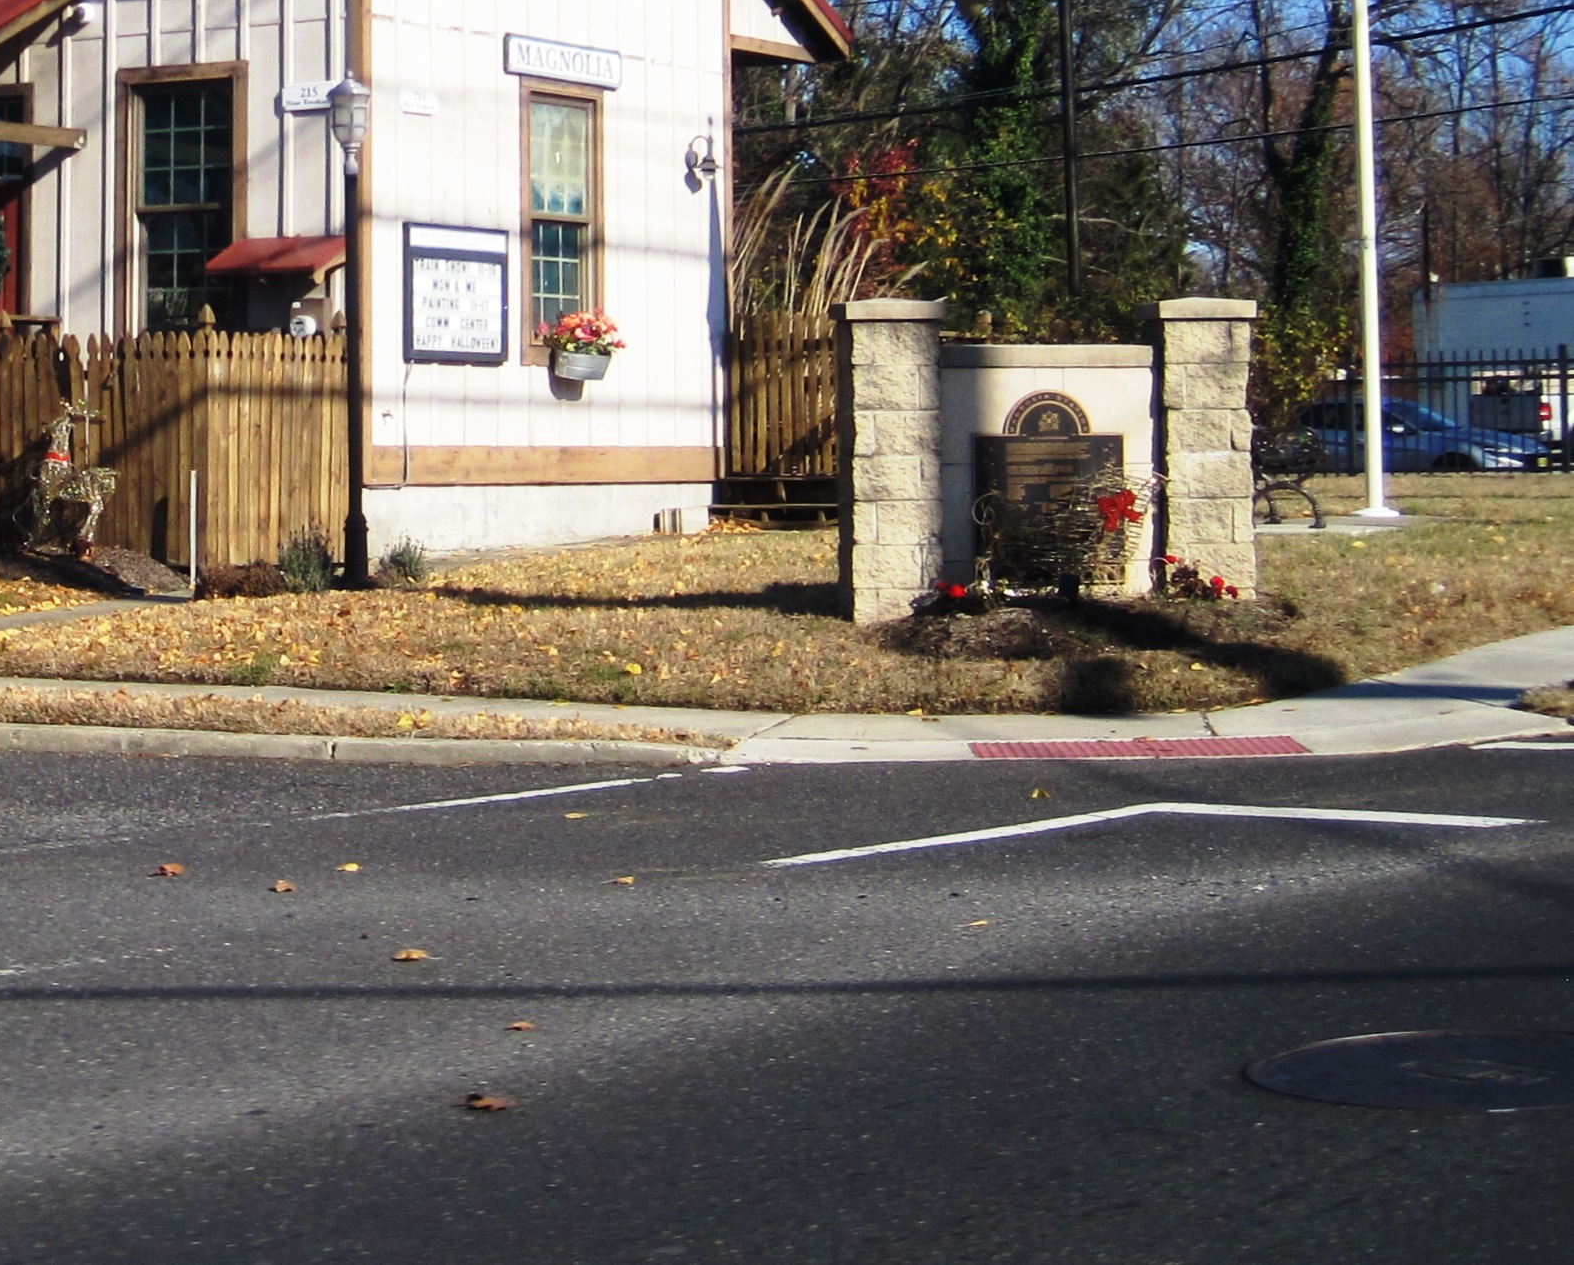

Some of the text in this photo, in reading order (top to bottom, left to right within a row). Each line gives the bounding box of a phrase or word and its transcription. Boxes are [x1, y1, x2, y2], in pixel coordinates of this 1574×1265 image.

[516, 42, 614, 80] MAGNOLIA
[300, 85, 318, 98] 215
[415, 257, 439, 272] TRAIN
[433, 279, 450, 291] MOM
[466, 281, 477, 294] ME
[423, 296, 460, 310] PAINTING
[426, 315, 488, 331] COMM CENTER
[416, 334, 499, 350] HAPPY HALLOWEEN!
